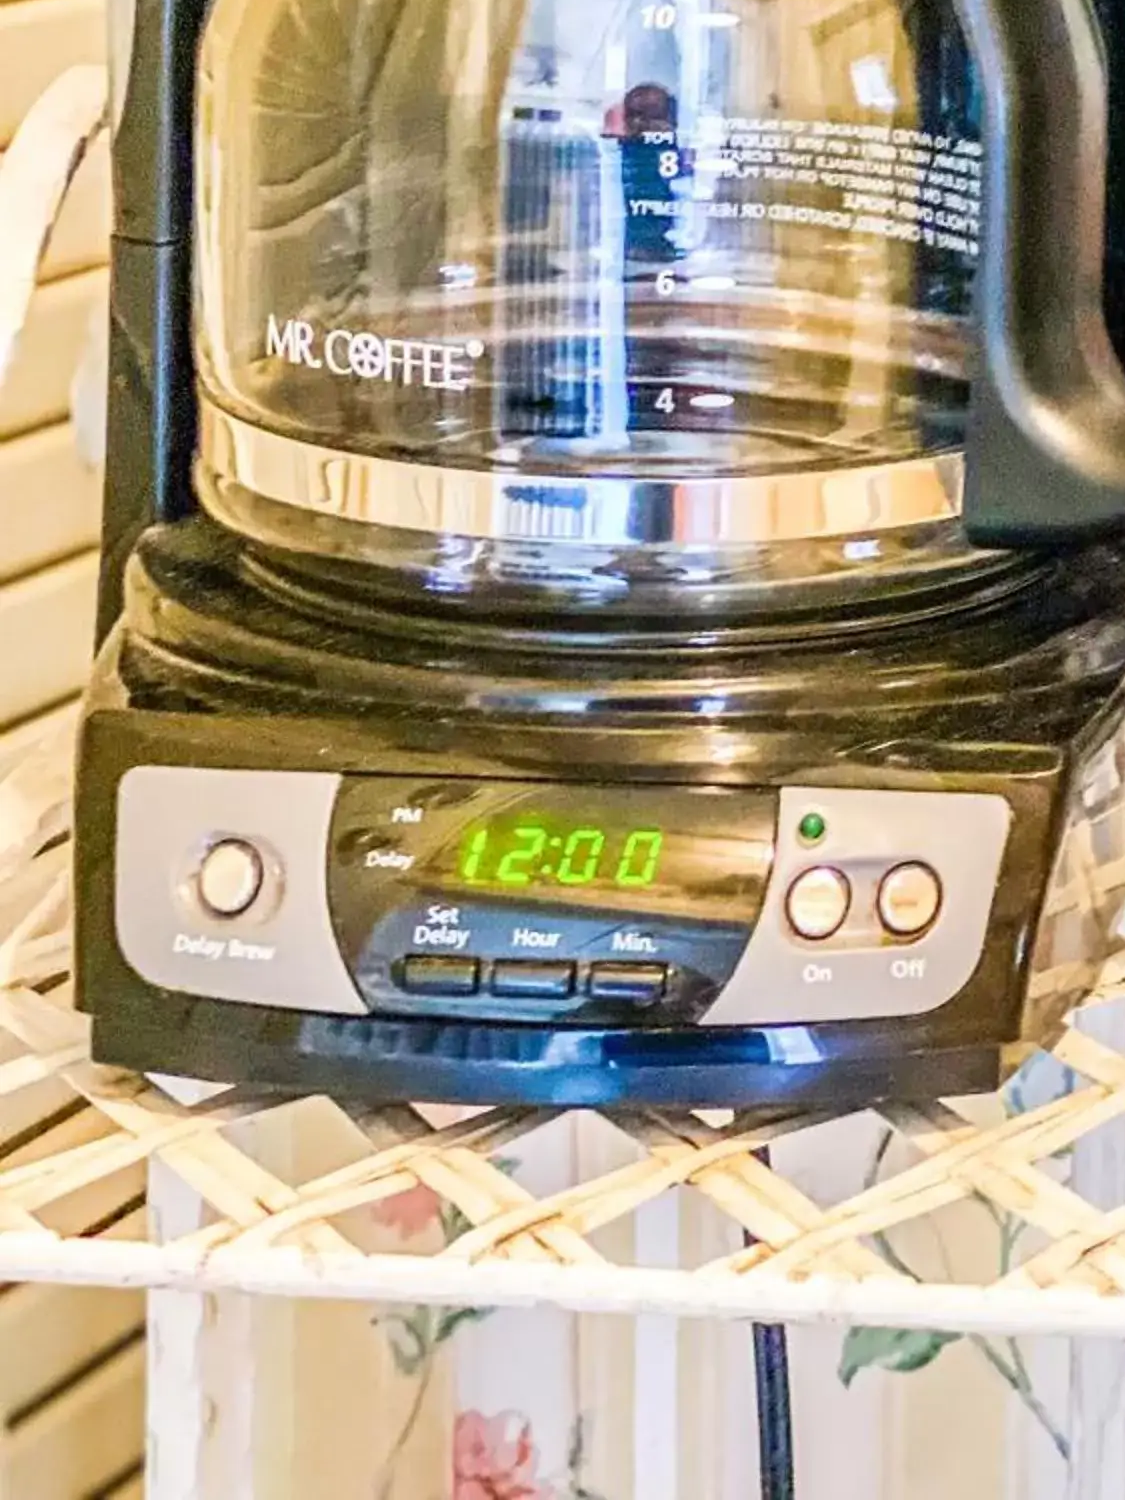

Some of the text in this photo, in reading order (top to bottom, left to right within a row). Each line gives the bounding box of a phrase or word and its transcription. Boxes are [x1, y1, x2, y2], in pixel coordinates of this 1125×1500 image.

[640, 3, 676, 30] 10
[658, 151, 680, 178] 8
[655, 269, 676, 296] 6
[265, 313, 323, 369] MR.
[654, 388, 676, 414] 4
[392, 807, 424, 823] PM
[365, 850, 415, 870] Delay
[462, 827, 663, 885] 12:00
[426, 905, 460, 924] Set
[172, 933, 227, 960] Delay
[413, 926, 471, 949] Delay
[511, 928, 562, 948] Hour
[612, 931, 657, 953] Min.
[802, 963, 833, 984] On
[890, 958, 926, 980] Off
